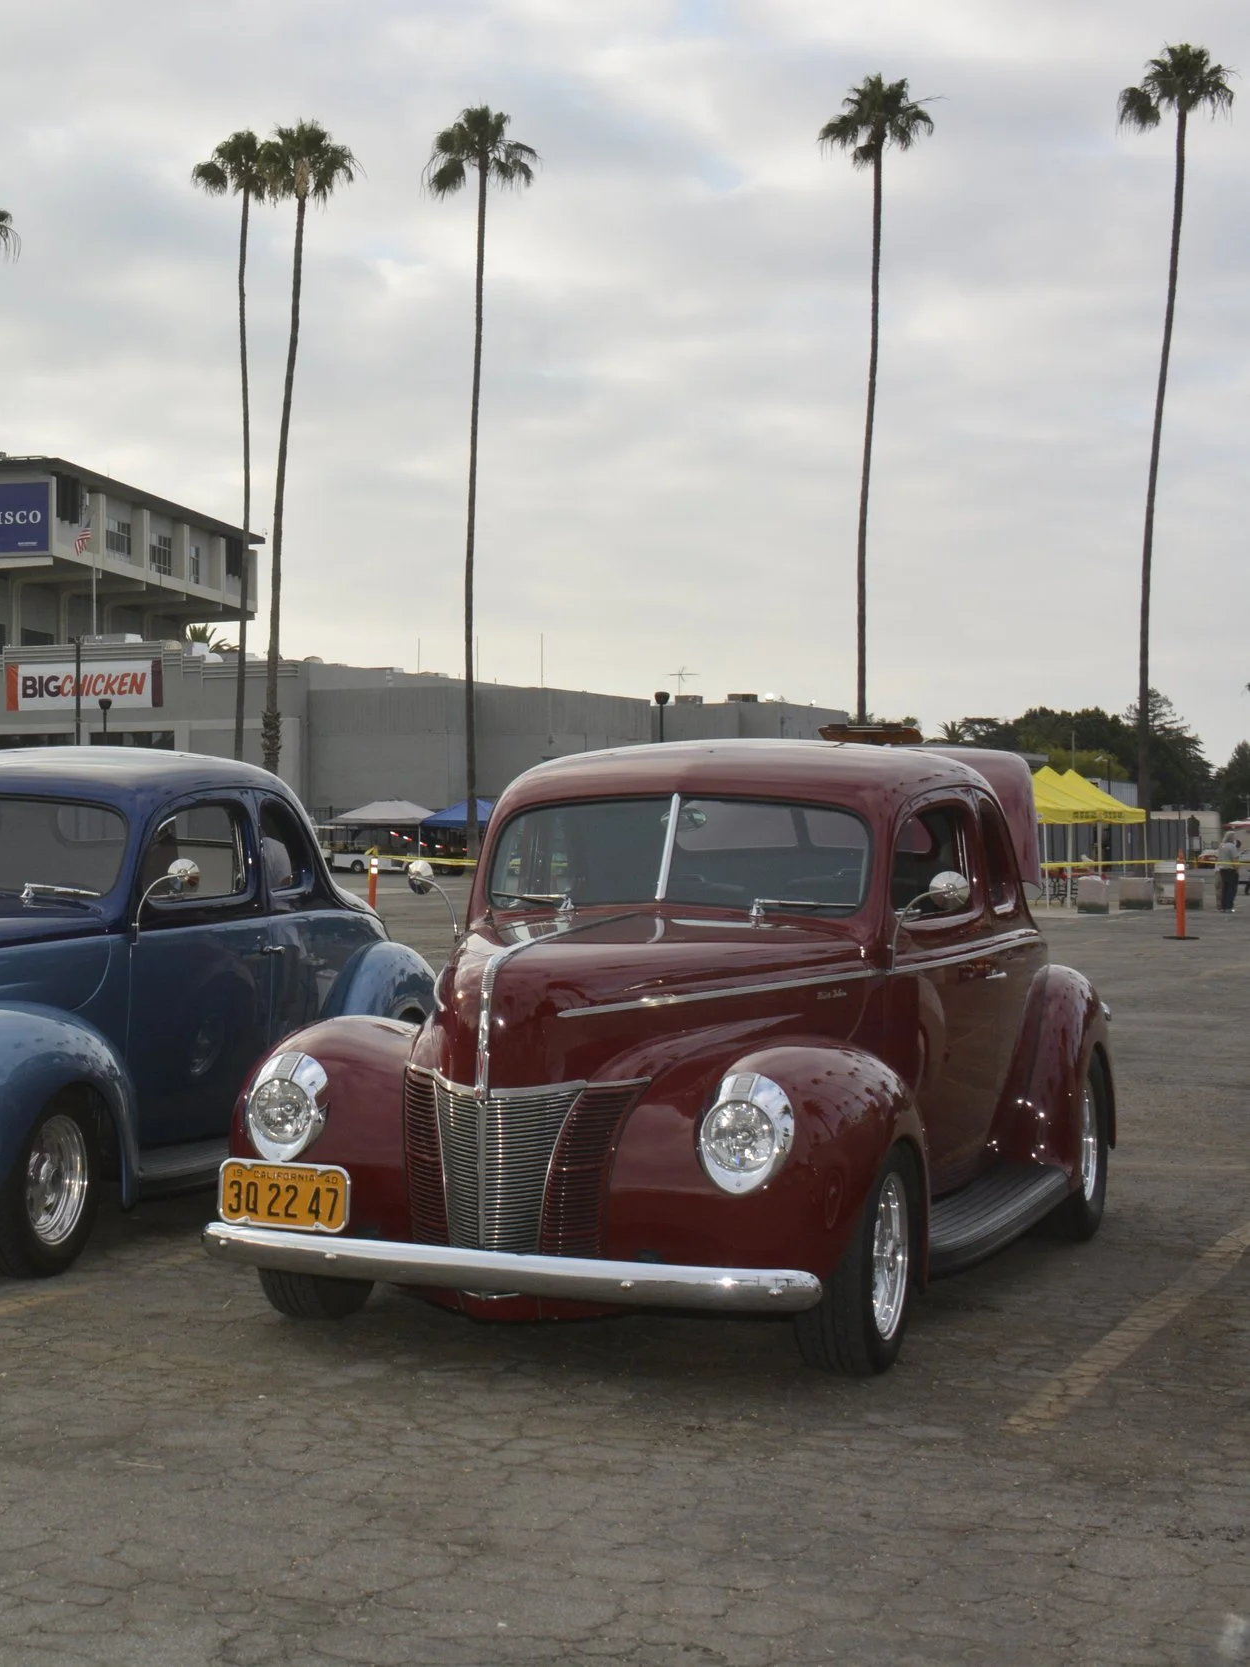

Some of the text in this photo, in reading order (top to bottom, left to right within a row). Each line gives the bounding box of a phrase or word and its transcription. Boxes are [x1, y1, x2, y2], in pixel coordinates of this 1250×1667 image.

[21, 672, 147, 699] BIG CHICKEN
[232, 1168, 338, 1185] 19 CALIFORNIA 40
[308, 1186, 339, 1222] 47
